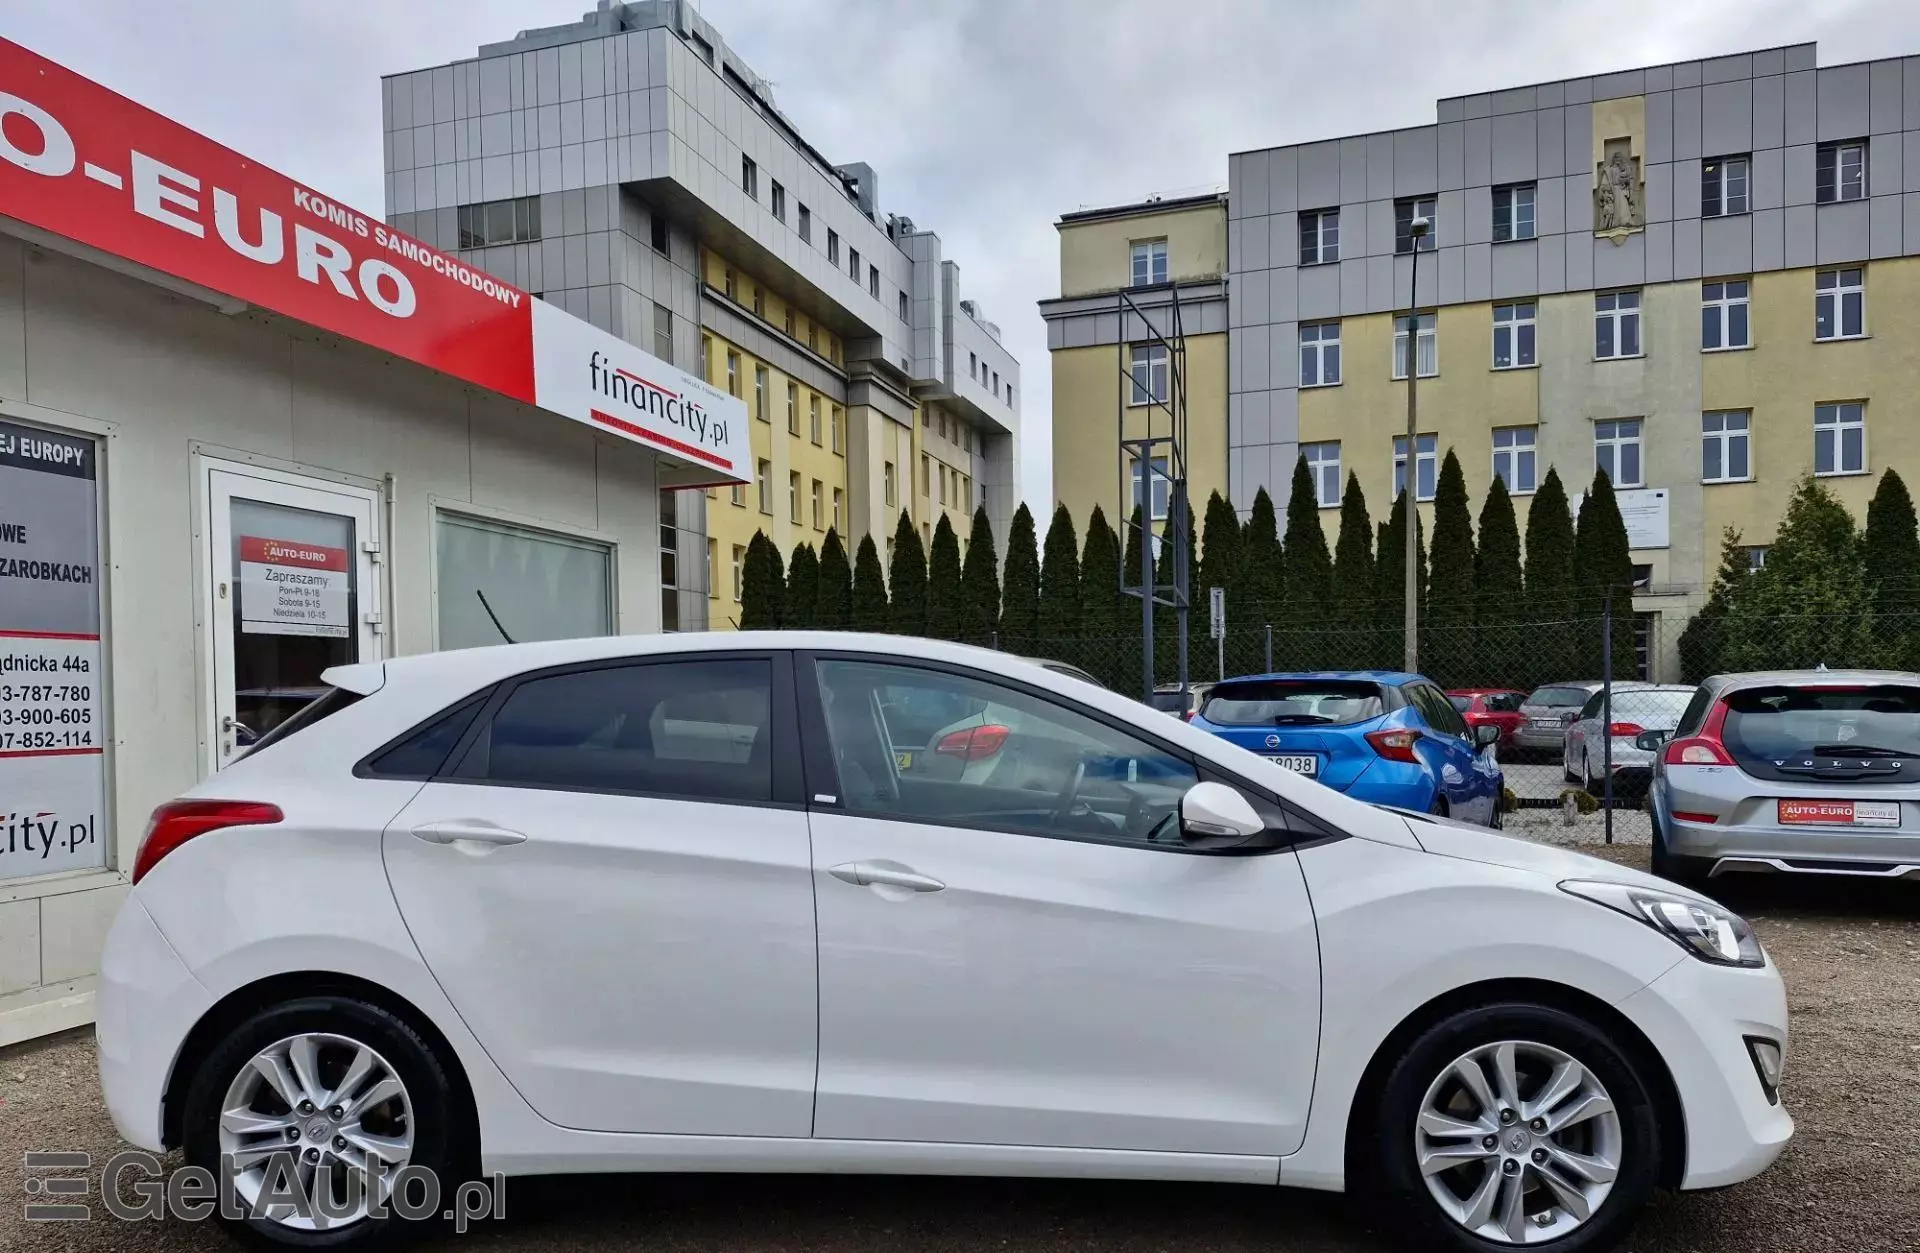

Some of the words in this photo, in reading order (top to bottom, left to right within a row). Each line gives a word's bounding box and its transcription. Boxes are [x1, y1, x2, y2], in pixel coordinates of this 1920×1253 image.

[293, 187, 369, 238] KOMIS
[374, 226, 521, 308] SAMOCHODOWY
[589, 351, 729, 447] financity.pl
[20, 437, 84, 466] EUROPY
[0, 523, 27, 544] WE
[270, 547, 326, 561] AUTO-EURO
[0, 558, 91, 584] ZAROBKACH
[279, 586, 303, 596] Pon-Pt
[279, 597, 303, 607] Sobota
[304, 599, 320, 608] 9-15
[273, 608, 305, 618] Niedziela
[307, 610, 326, 619] 10-15
[62, 655, 89, 673] 44a
[0, 685, 90, 701] 3-787-780
[0, 708, 91, 725] 3-900-605
[1268, 757, 1312, 772] 8038
[1774, 760, 1901, 768] VOLVO
[1786, 806, 1853, 816] AUTO-EURO
